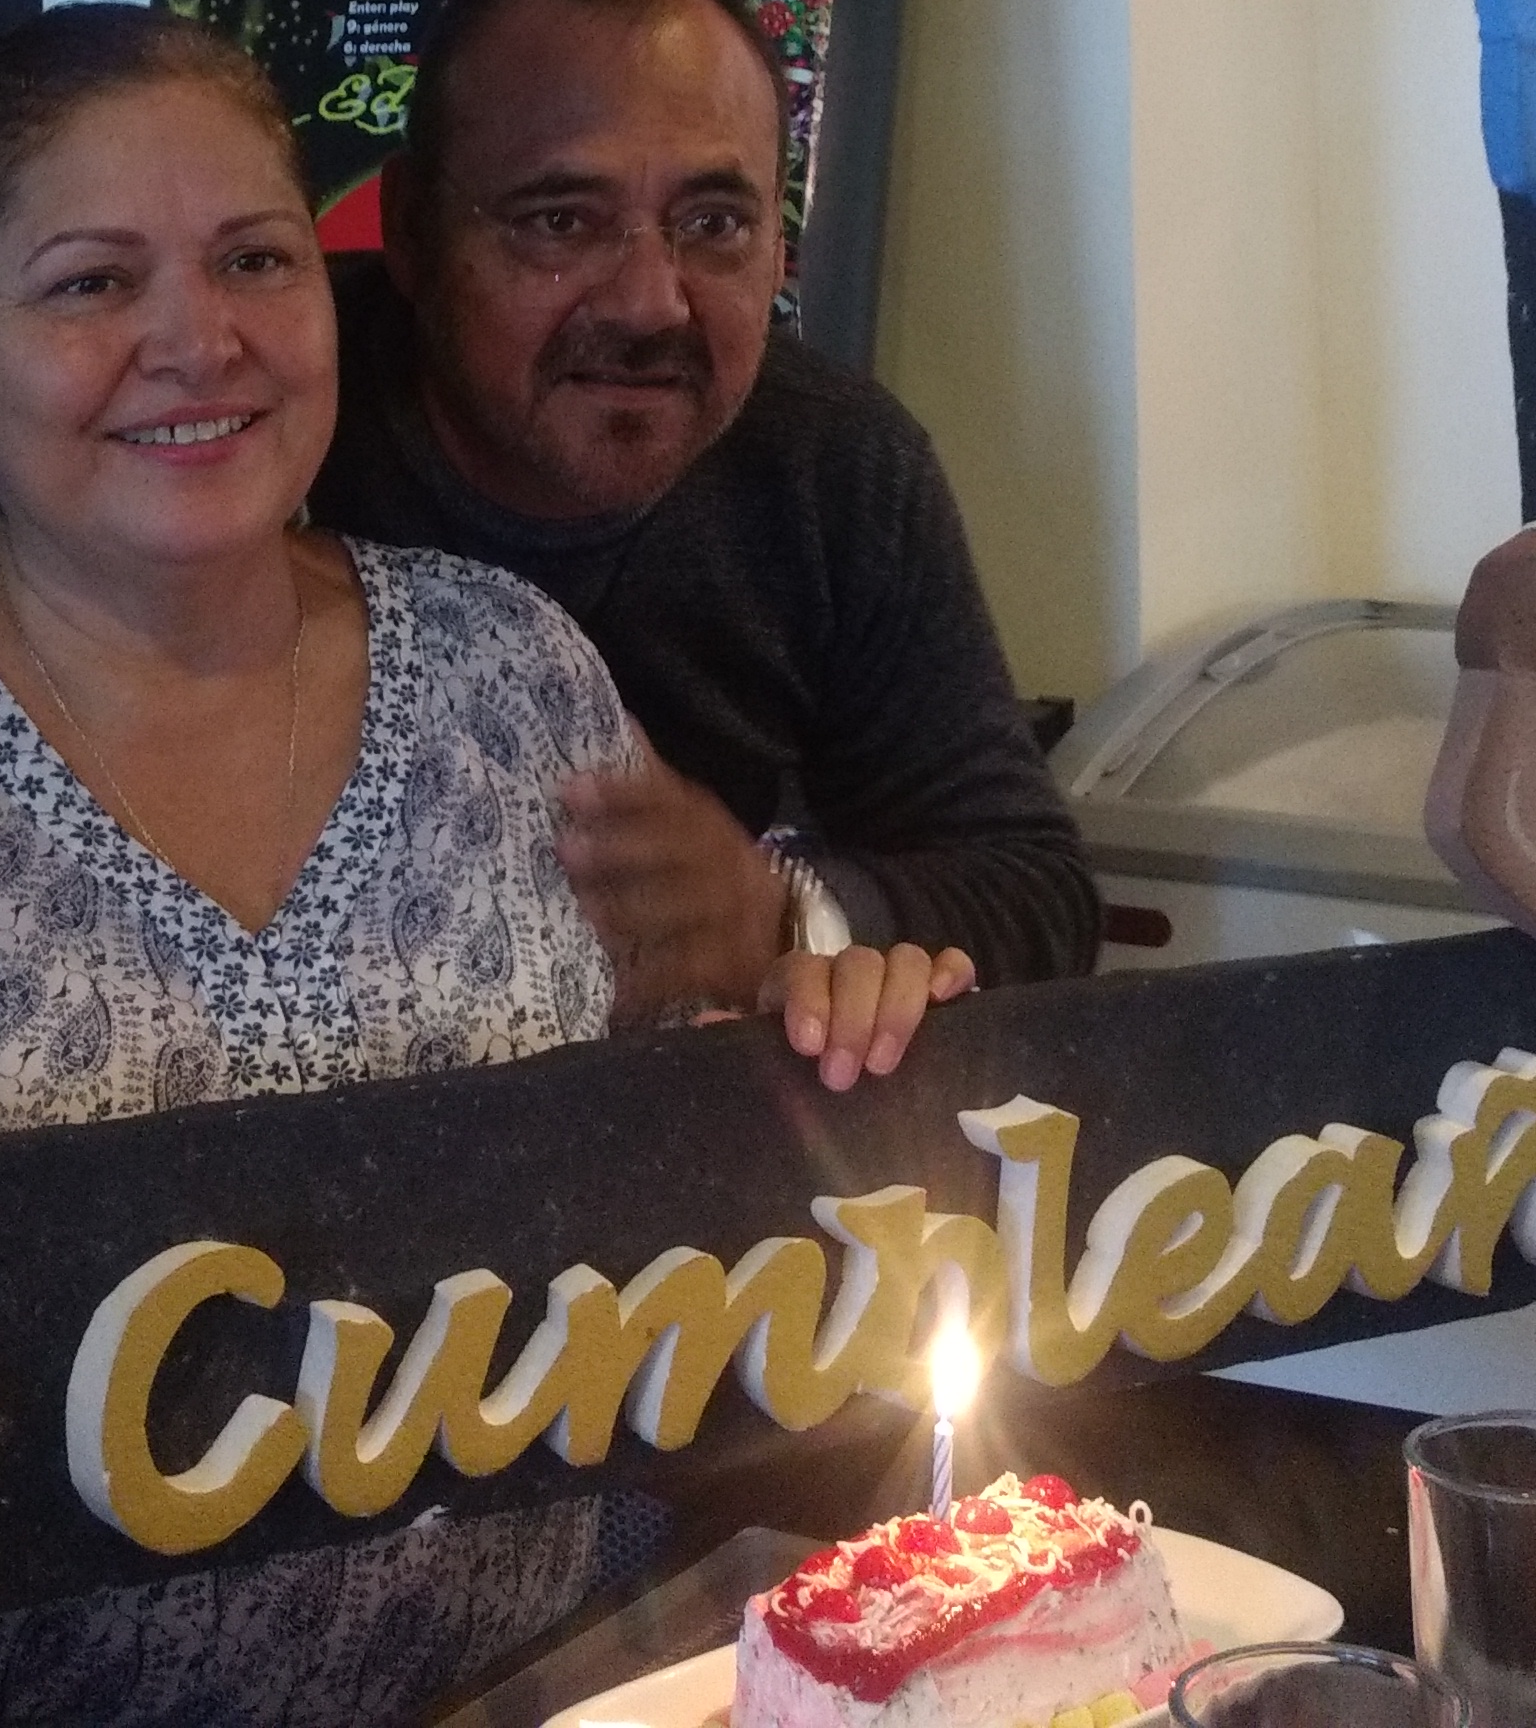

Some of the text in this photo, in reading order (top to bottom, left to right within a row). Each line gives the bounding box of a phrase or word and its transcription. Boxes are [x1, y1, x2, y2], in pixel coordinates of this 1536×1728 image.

[389, 0, 420, 16] play
[363, 19, 408, 36] género
[359, 39, 412, 54] derecha
